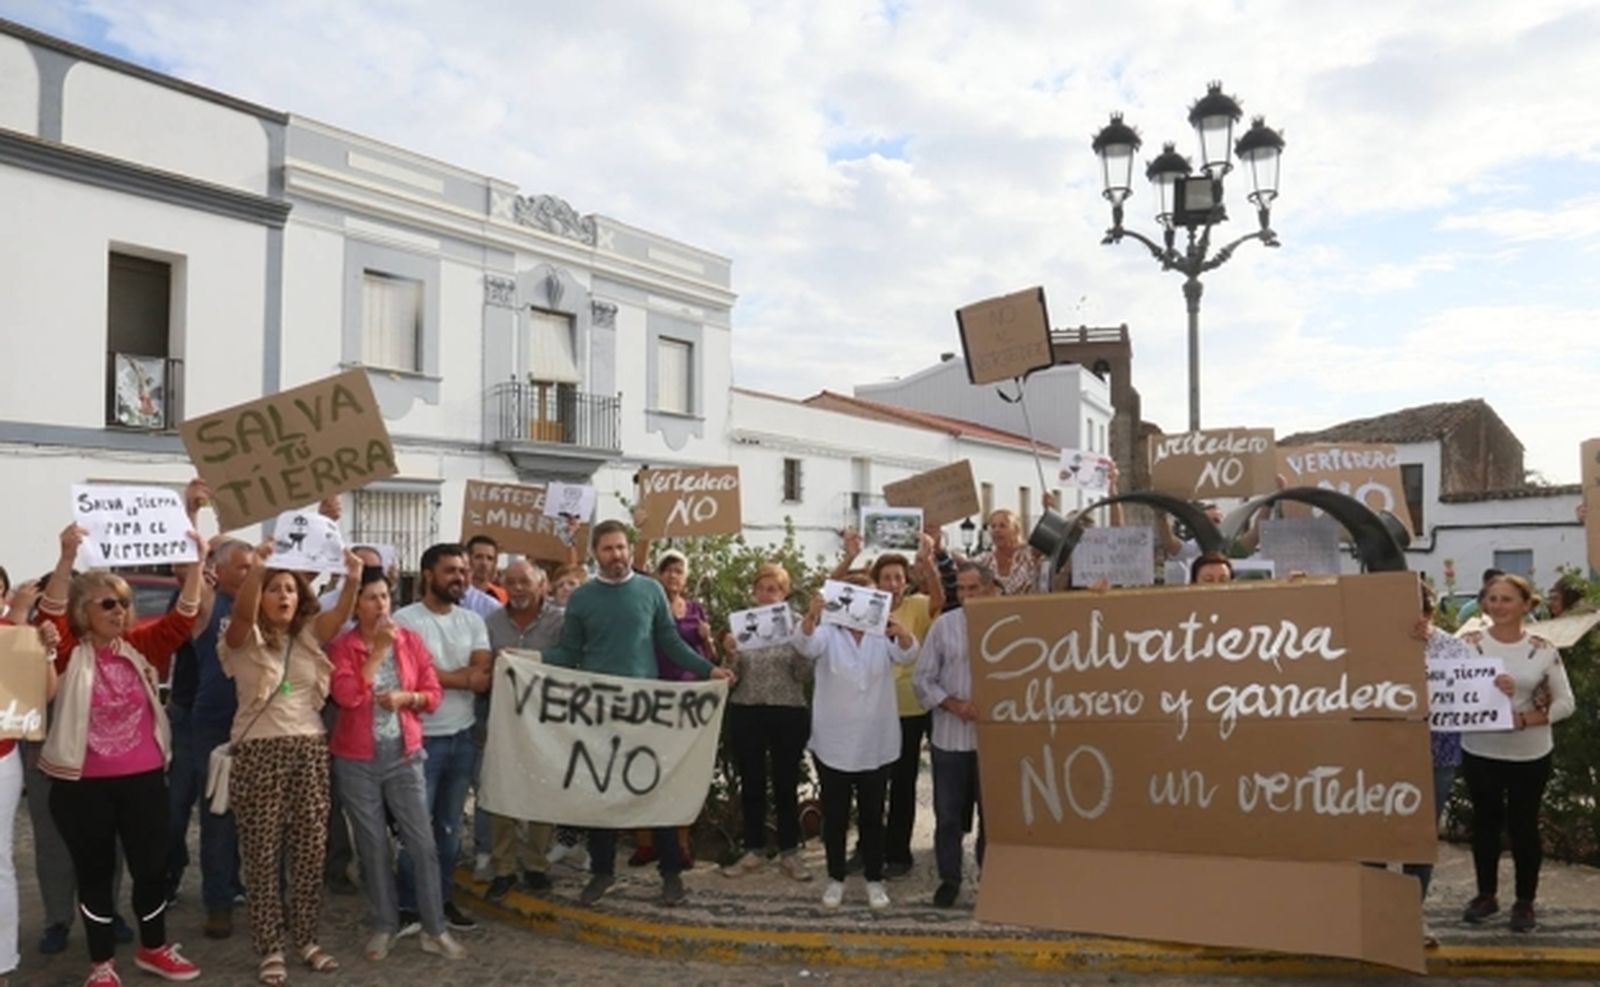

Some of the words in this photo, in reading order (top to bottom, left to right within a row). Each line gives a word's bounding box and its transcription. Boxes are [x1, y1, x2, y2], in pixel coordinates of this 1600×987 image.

[196, 383, 365, 464] SALVA
[469, 484, 546, 511] VERTEDE
[1194, 457, 1245, 493] NO
[665, 494, 718, 528] NO
[980, 610, 1347, 679] Salvatierra
[506, 667, 721, 729] VERTEDERO
[991, 677, 1145, 737] alfarero
[1160, 689, 1194, 740] y
[1206, 673, 1419, 740] ganadero
[563, 735, 661, 796] NO
[1020, 744, 1113, 826] NO
[1149, 768, 1221, 809] un
[1238, 765, 1422, 816] vertedero
